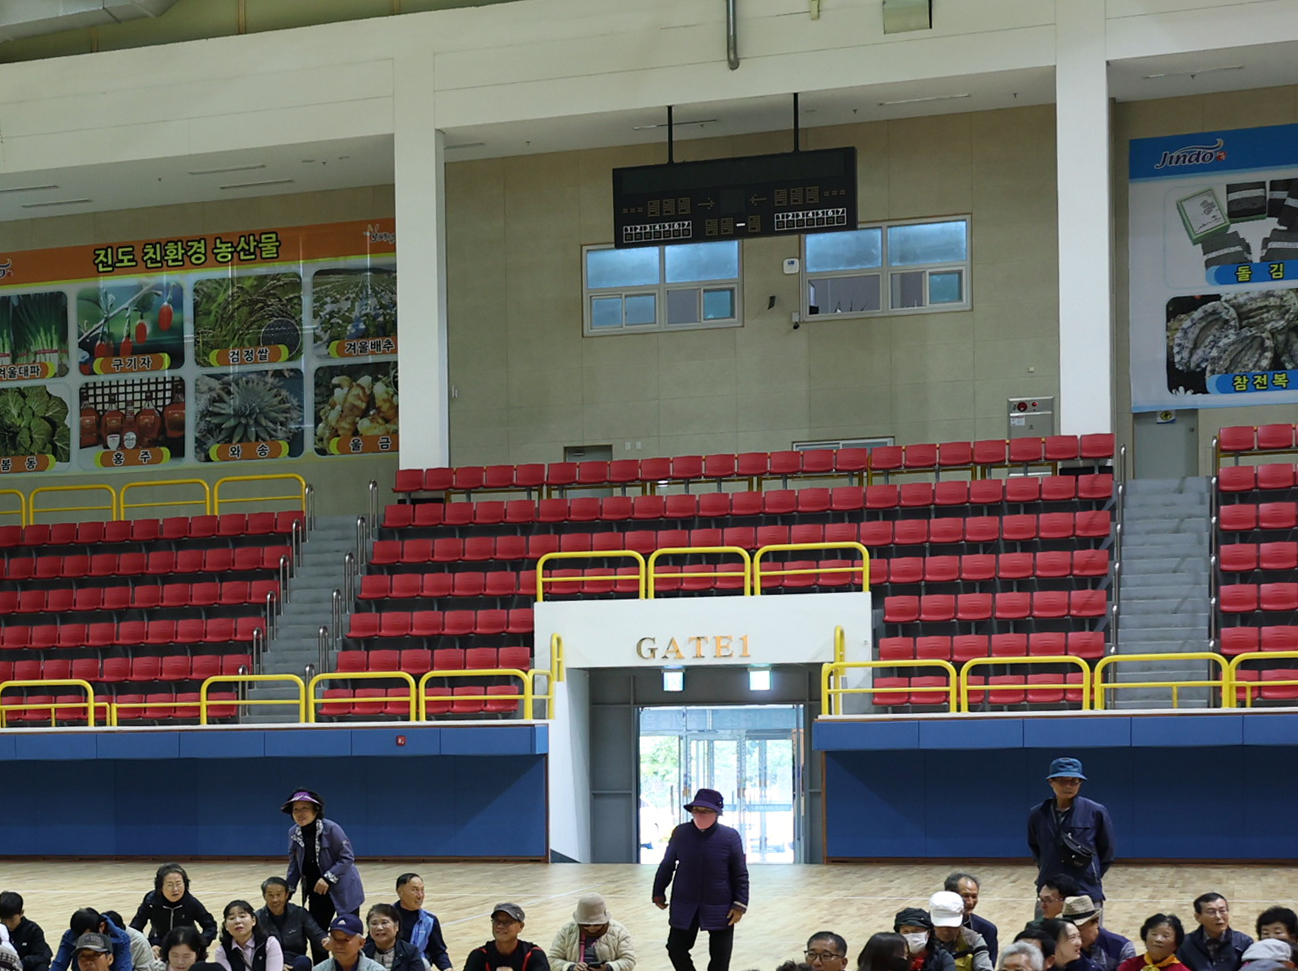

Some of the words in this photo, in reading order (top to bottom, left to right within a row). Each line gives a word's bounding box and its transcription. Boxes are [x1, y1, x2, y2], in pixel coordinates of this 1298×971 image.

[1154, 148, 1215, 169] Jindo
[93, 246, 138, 273] 진도
[142, 239, 207, 269] 친환경
[213, 232, 281, 262] 농산물
[345, 337, 395, 354] 겨울배추
[112, 356, 152, 371] 구기자
[229, 347, 269, 363] 검정쌀
[1233, 373, 1288, 391] 참전복
[635, 635, 751, 660] GATE1
